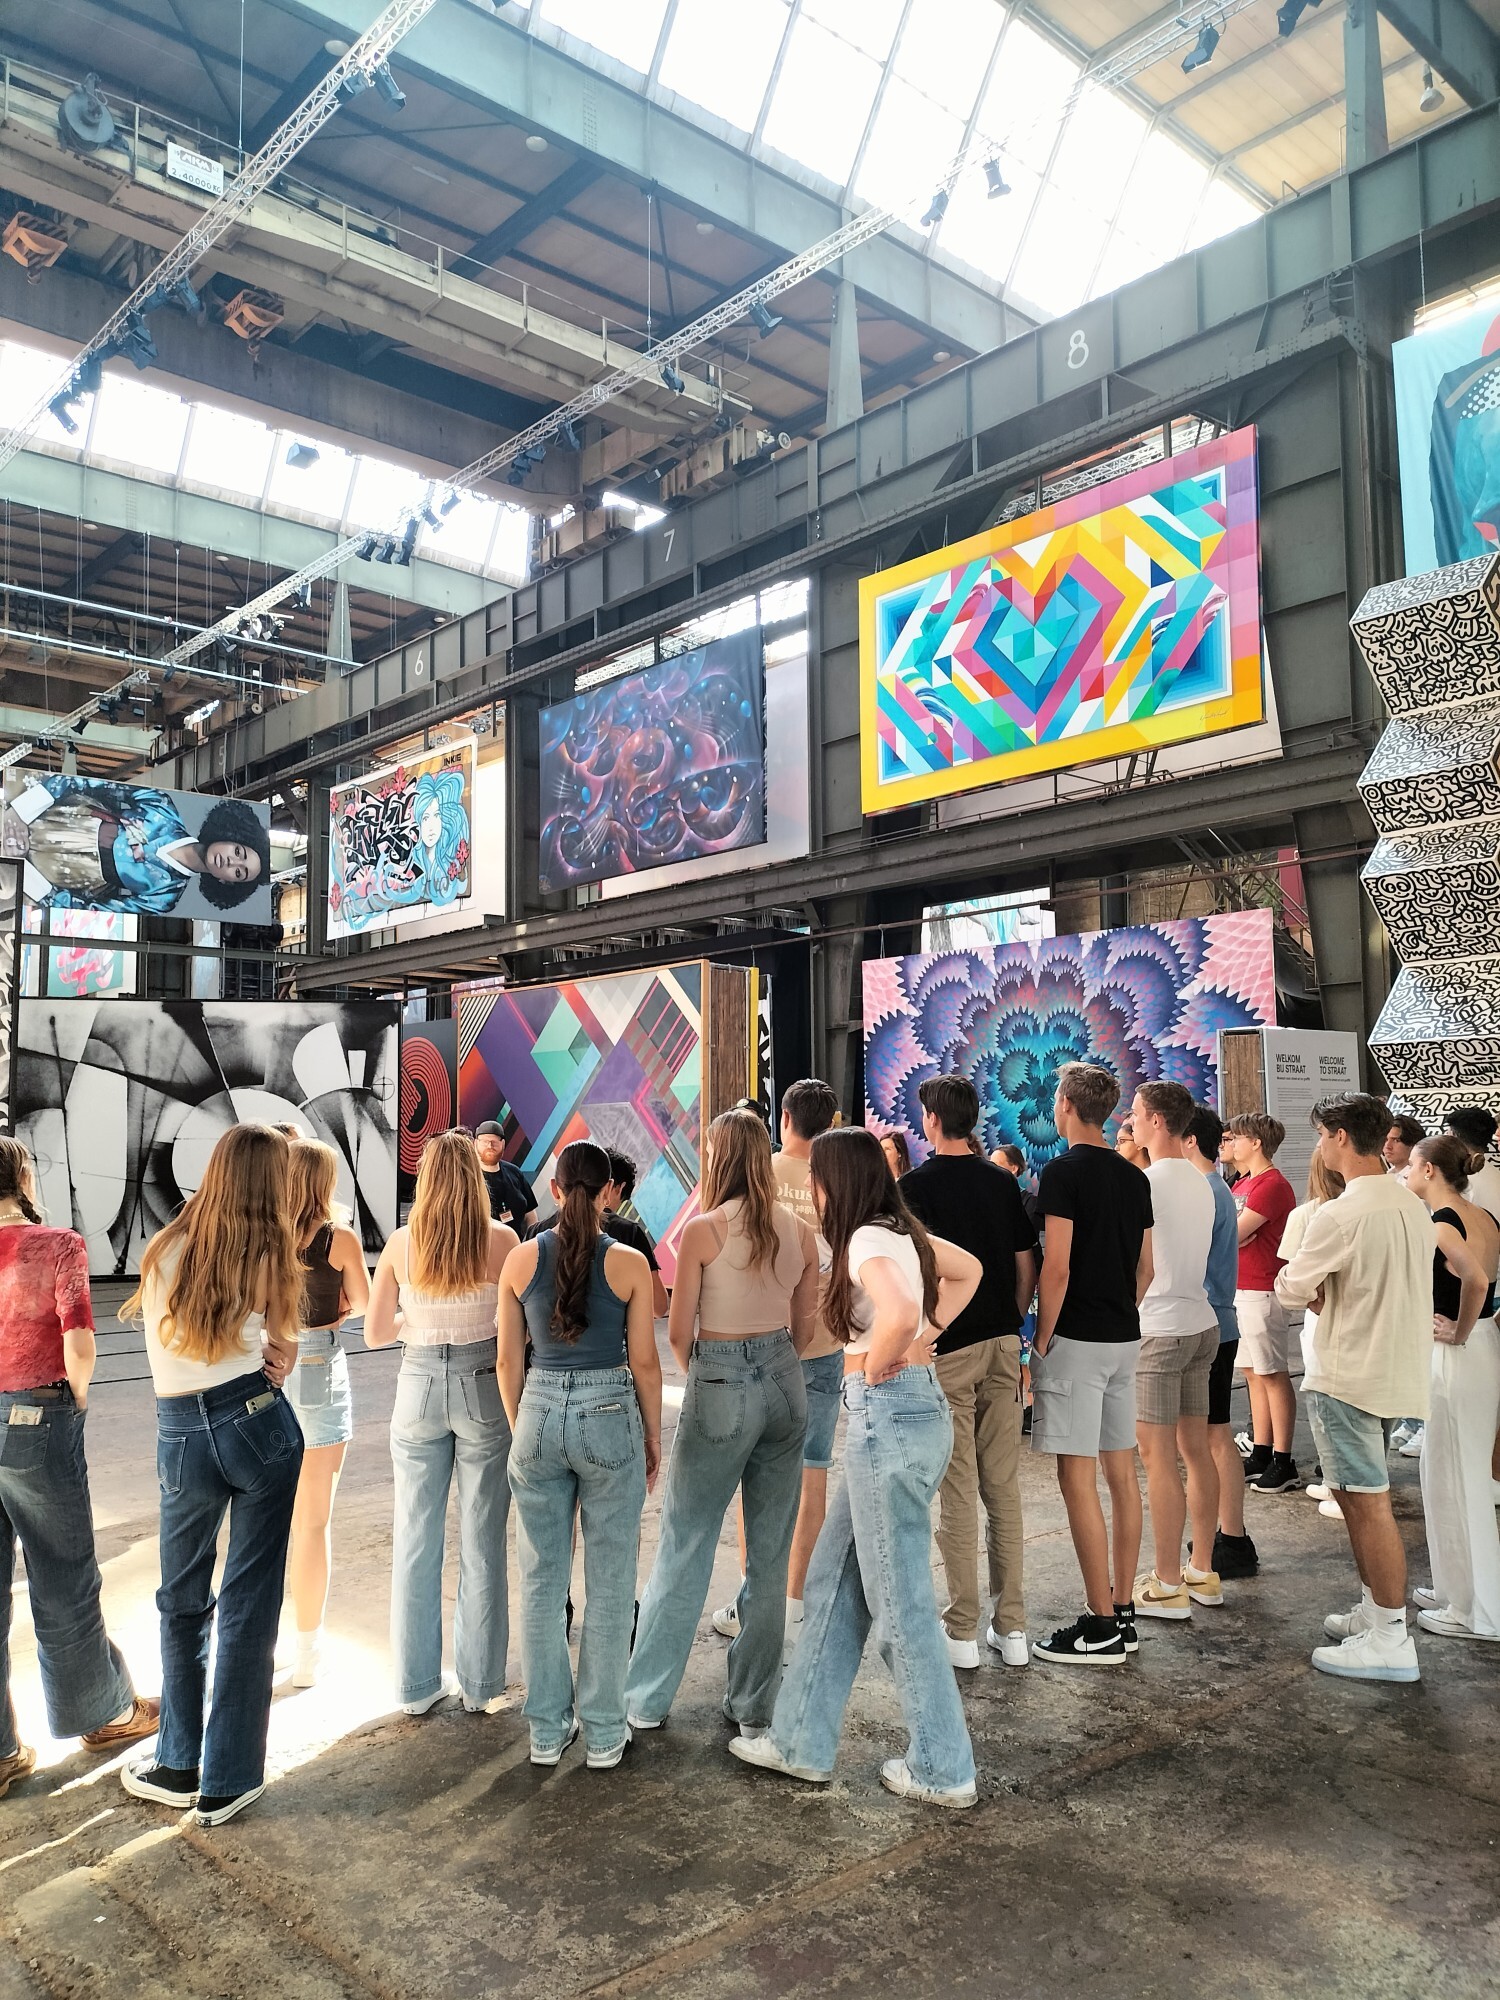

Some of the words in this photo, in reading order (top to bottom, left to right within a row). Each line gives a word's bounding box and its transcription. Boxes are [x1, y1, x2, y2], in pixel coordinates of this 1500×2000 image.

[1068, 329, 1089, 369] 8
[663, 528, 675, 562] 7
[415, 650, 424, 676] 6
[443, 753, 462, 767] INKIE
[1276, 1054, 1301, 1064] WELKOM
[1319, 1056, 1345, 1066] WELCOME
[1276, 1064, 1284, 1073] BIJ
[1285, 1064, 1307, 1074] STRAAT
[1319, 1066, 1327, 1075] TO
[1327, 1066, 1347, 1076] STRAAT
[777, 1182, 813, 1201] okus
